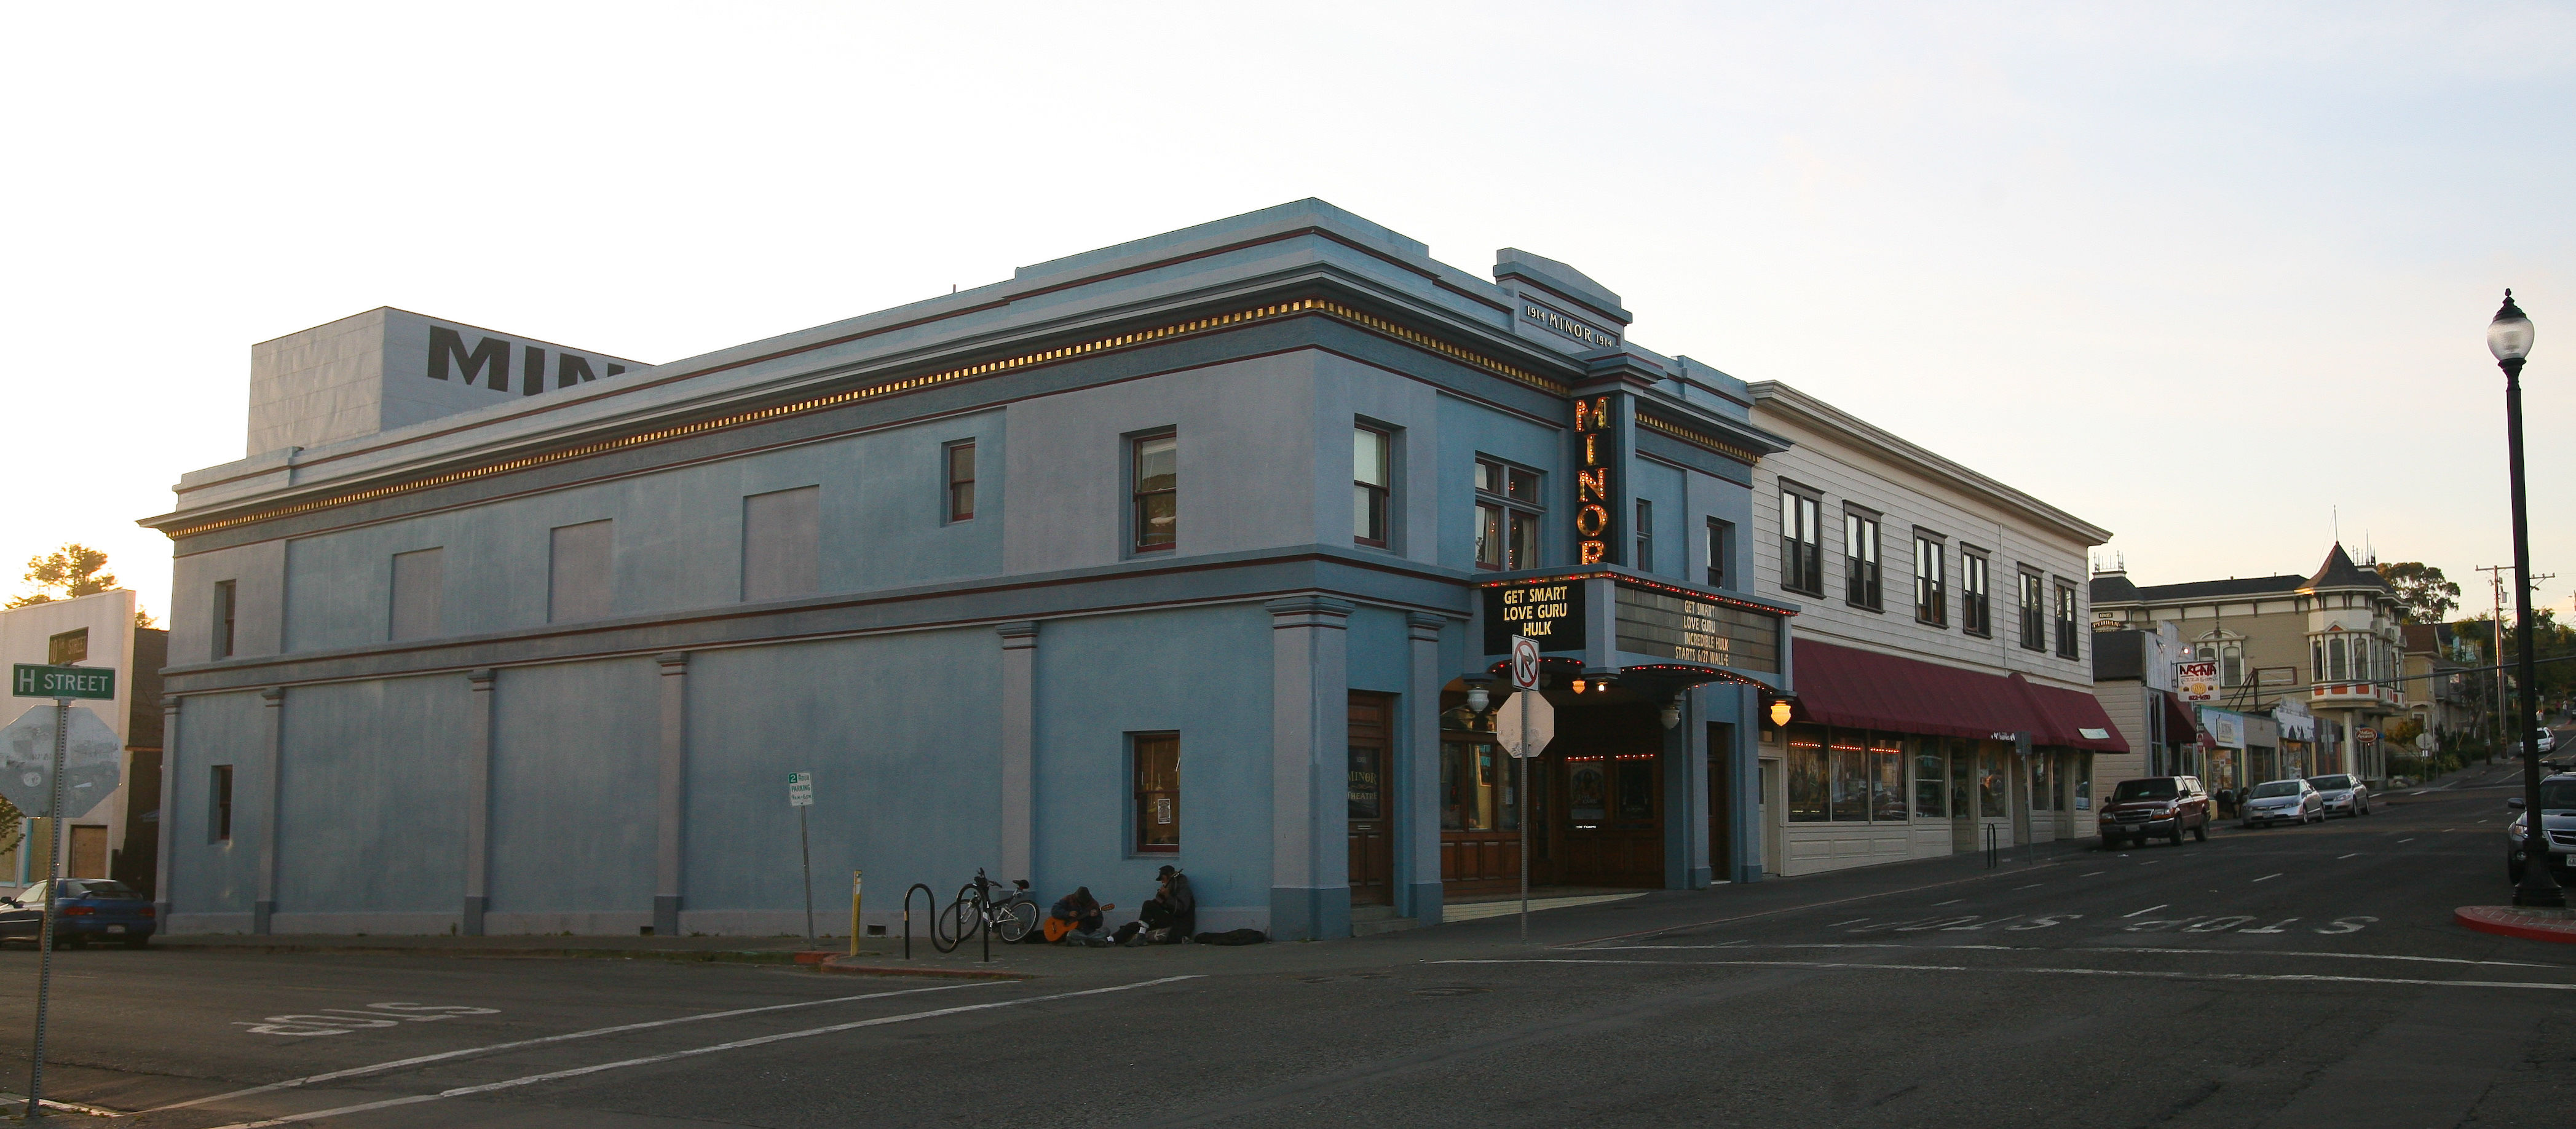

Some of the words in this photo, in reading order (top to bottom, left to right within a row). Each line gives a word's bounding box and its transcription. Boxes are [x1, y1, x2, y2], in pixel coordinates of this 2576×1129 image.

[1527, 306, 1545, 322] 1914
[1549, 313, 1592, 343] MINOR
[1595, 334, 1613, 347] 1914
[1574, 396, 1611, 565] MINOR
[1504, 589, 1525, 604] GET
[1529, 586, 1568, 603] SMART
[1504, 606, 1533, 621] LOVE
[1538, 603, 1567, 619] GURU
[1685, 600, 1695, 614] GET
[1697, 603, 1715, 617] SMART
[1523, 620, 1552, 636] HULK
[1683, 616, 1699, 630] LOVE
[1701, 619, 1715, 633] GURU
[1685, 632, 1715, 648] INCREDIBLE
[1716, 637, 1729, 651] HULK
[1675, 646, 1696, 661] STARTS
[1697, 649, 1709, 663] 6/27
[1710, 651, 1729, 667] WALL-E
[2179, 662, 2217, 676] ARCATA
[19, 668, 35, 693] H
[44, 673, 109, 692] STREET
[1347, 791, 1378, 799] THEATRE
